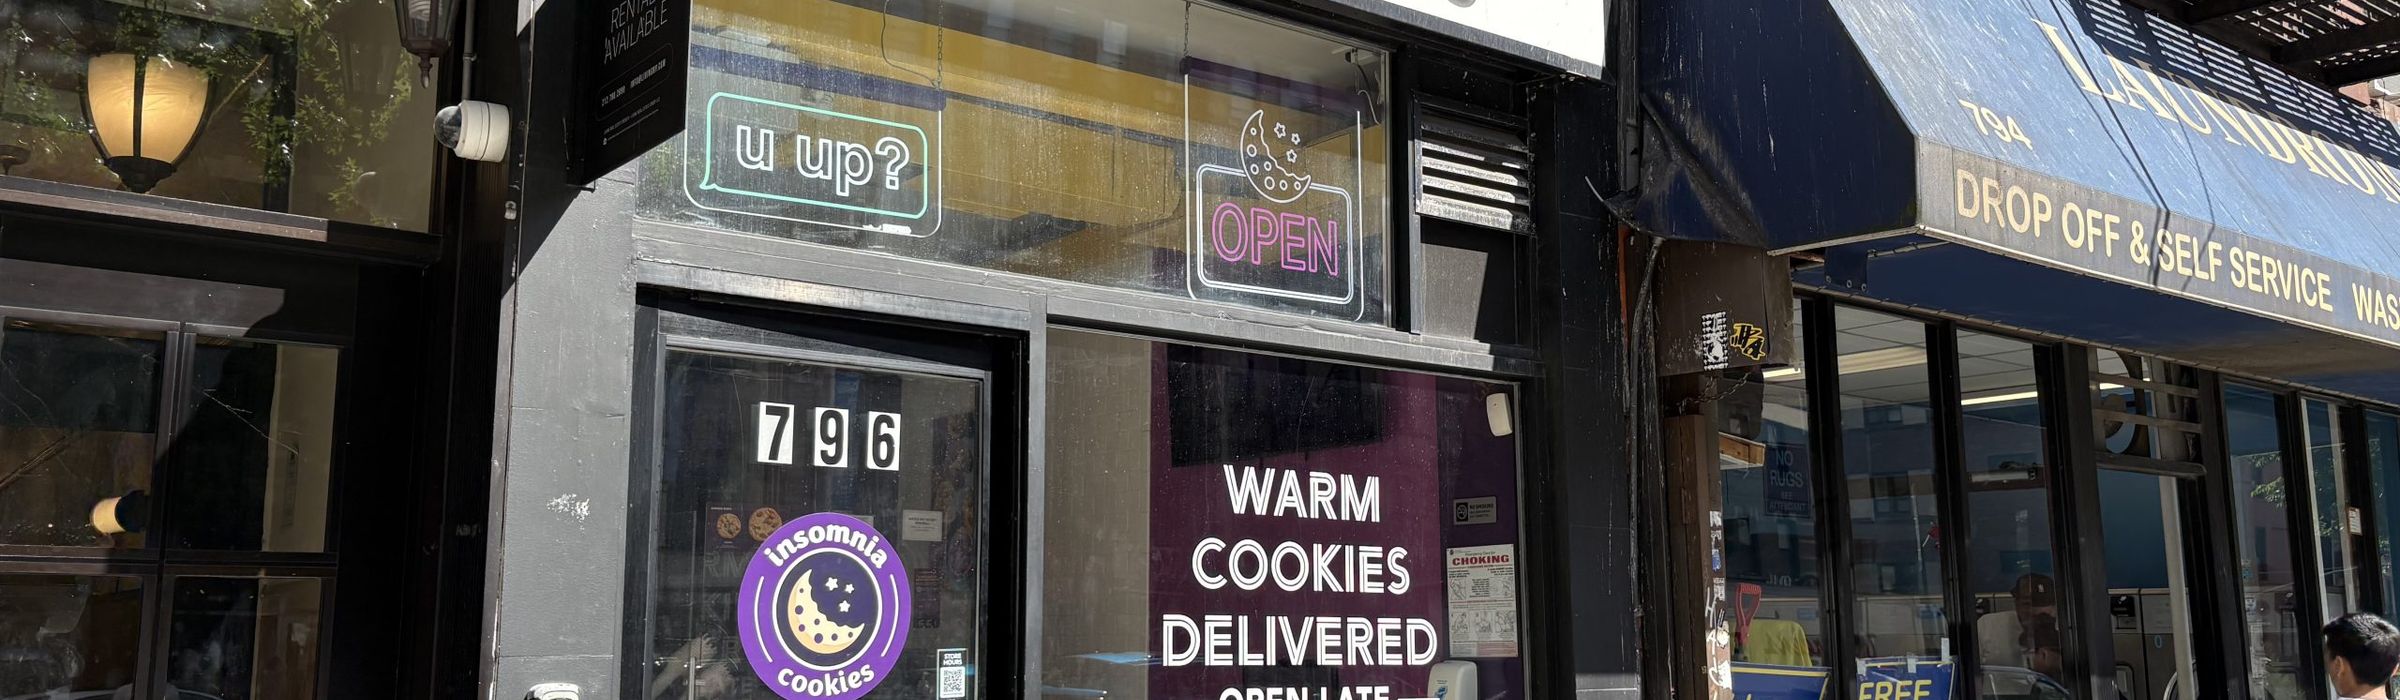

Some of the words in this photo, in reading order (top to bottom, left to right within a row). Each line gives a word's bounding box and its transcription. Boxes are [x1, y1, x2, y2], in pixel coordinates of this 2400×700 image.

[604, 0, 668, 64] AVAILABLE
[1959, 98, 2033, 150] 794
[736, 124, 774, 171] u
[796, 134, 910, 196] up?
[1211, 202, 1339, 277] OPEN
[1956, 168, 2052, 238] DROP
[2061, 202, 2121, 258] OFF
[2130, 220, 2150, 267] &
[2156, 228, 2223, 283] SELF
[2229, 246, 2334, 313] SERVICE
[2351, 282, 2400, 331] WAS
[765, 404, 896, 469] 796
[1776, 449, 1794, 467] NO
[1223, 464, 1380, 523] WARM
[1770, 469, 1805, 488] RUGS
[763, 523, 888, 569] insomnia
[1192, 537, 1411, 595] COOKIES
[1452, 554, 1509, 566] CHOKING
[1162, 613, 1438, 667] DELIVERED
[777, 663, 875, 697] cookies
[1858, 679, 1932, 700] FREE
